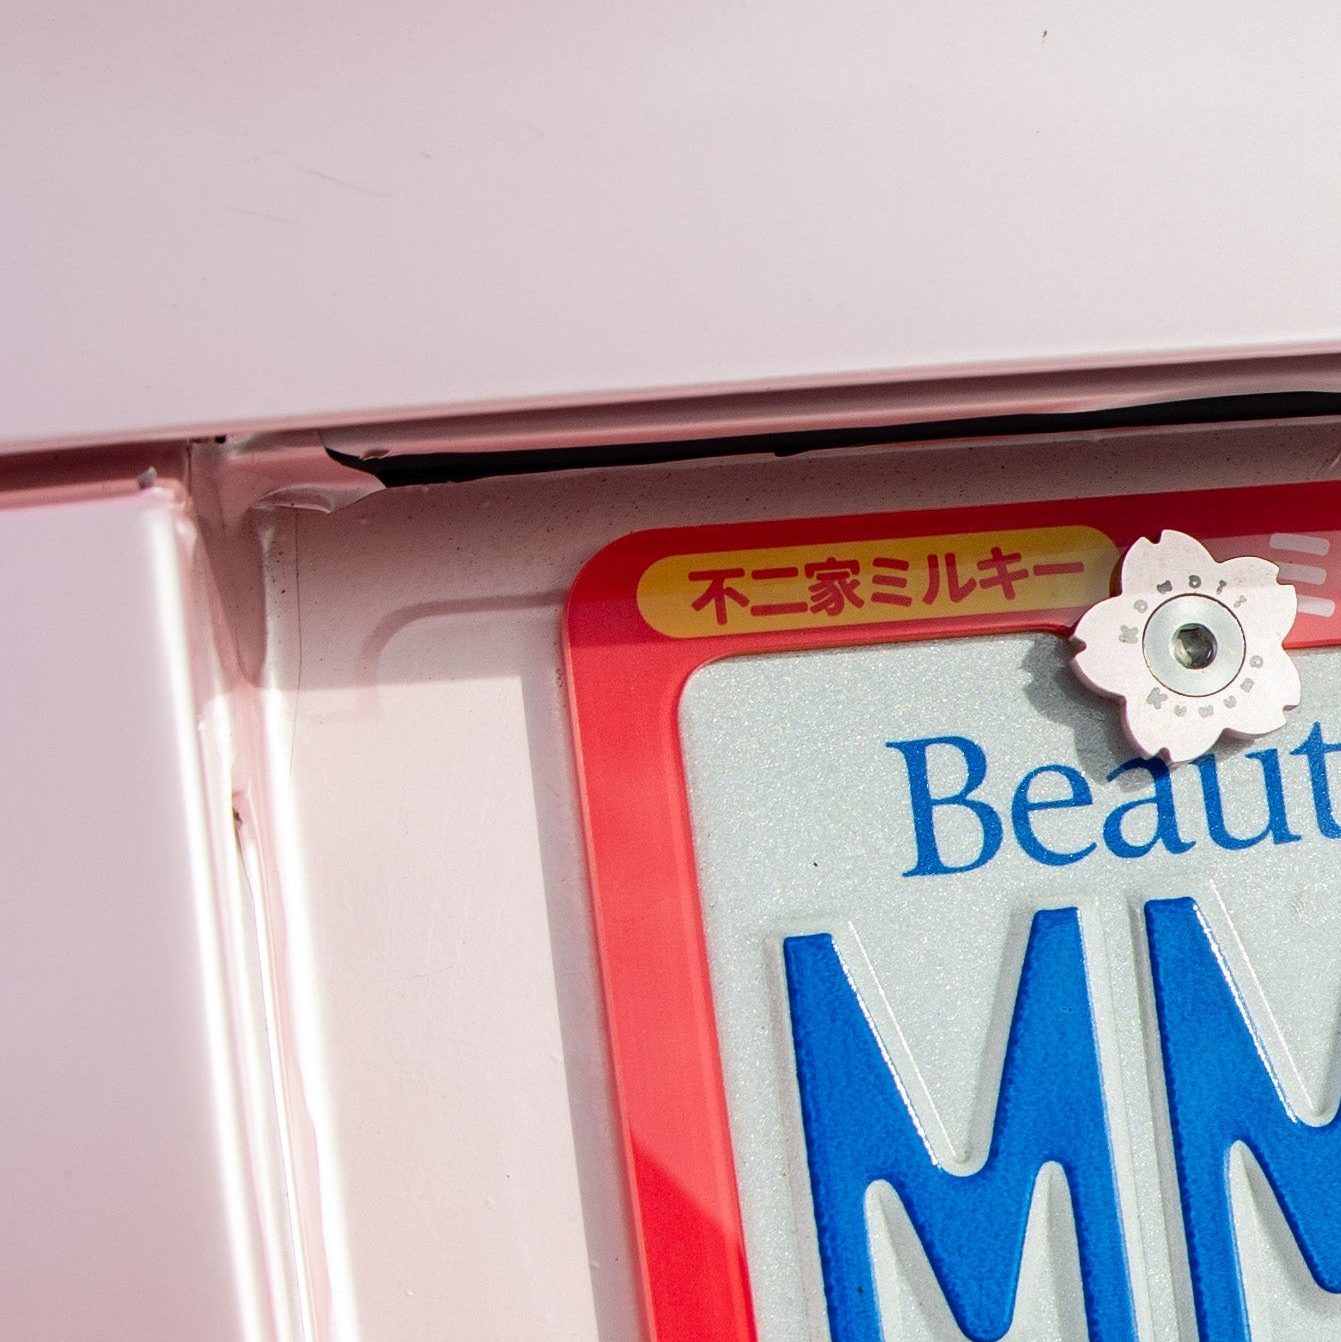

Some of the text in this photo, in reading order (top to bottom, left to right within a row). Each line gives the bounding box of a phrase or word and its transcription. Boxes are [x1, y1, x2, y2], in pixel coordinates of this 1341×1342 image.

[690, 550, 1086, 625] 不二家ミルキー
